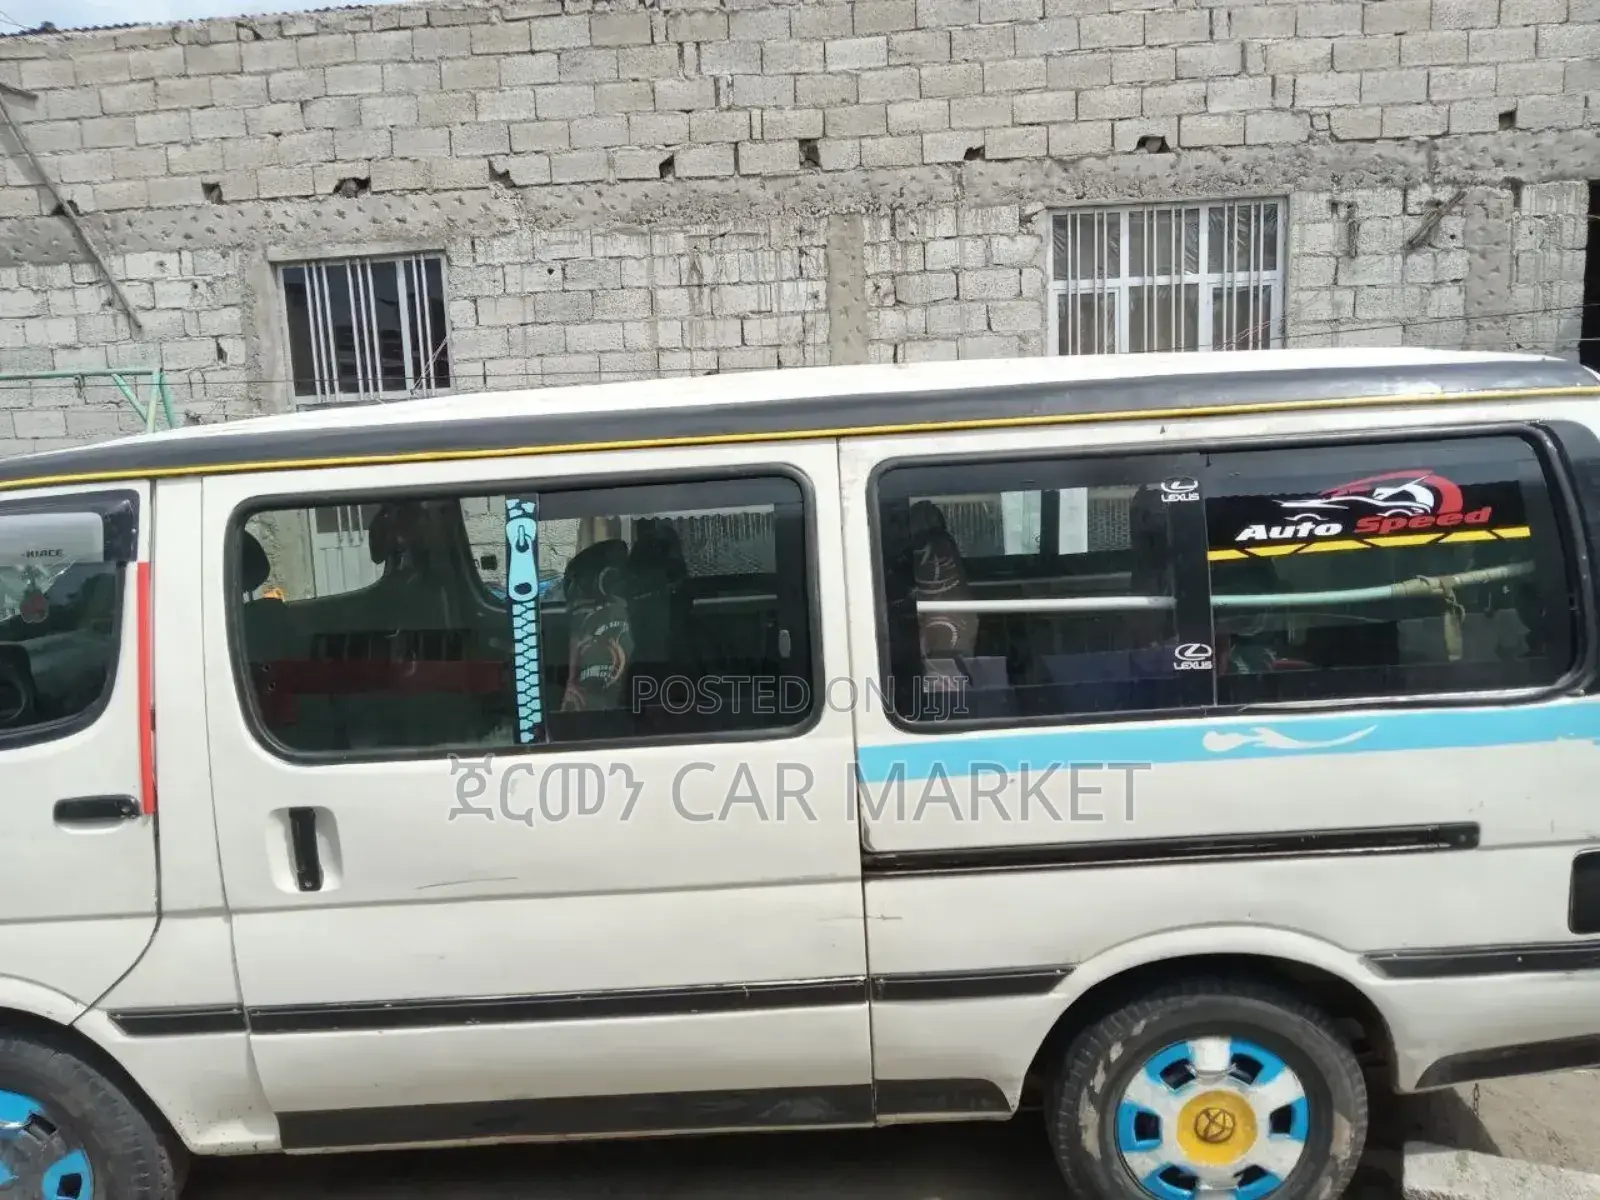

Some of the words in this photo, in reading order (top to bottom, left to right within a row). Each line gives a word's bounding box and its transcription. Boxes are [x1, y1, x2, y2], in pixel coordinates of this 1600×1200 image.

[1160, 493, 1200, 502] LEXUS
[1234, 522, 1343, 541] Auto
[1173, 660, 1213, 670] LEXUS
